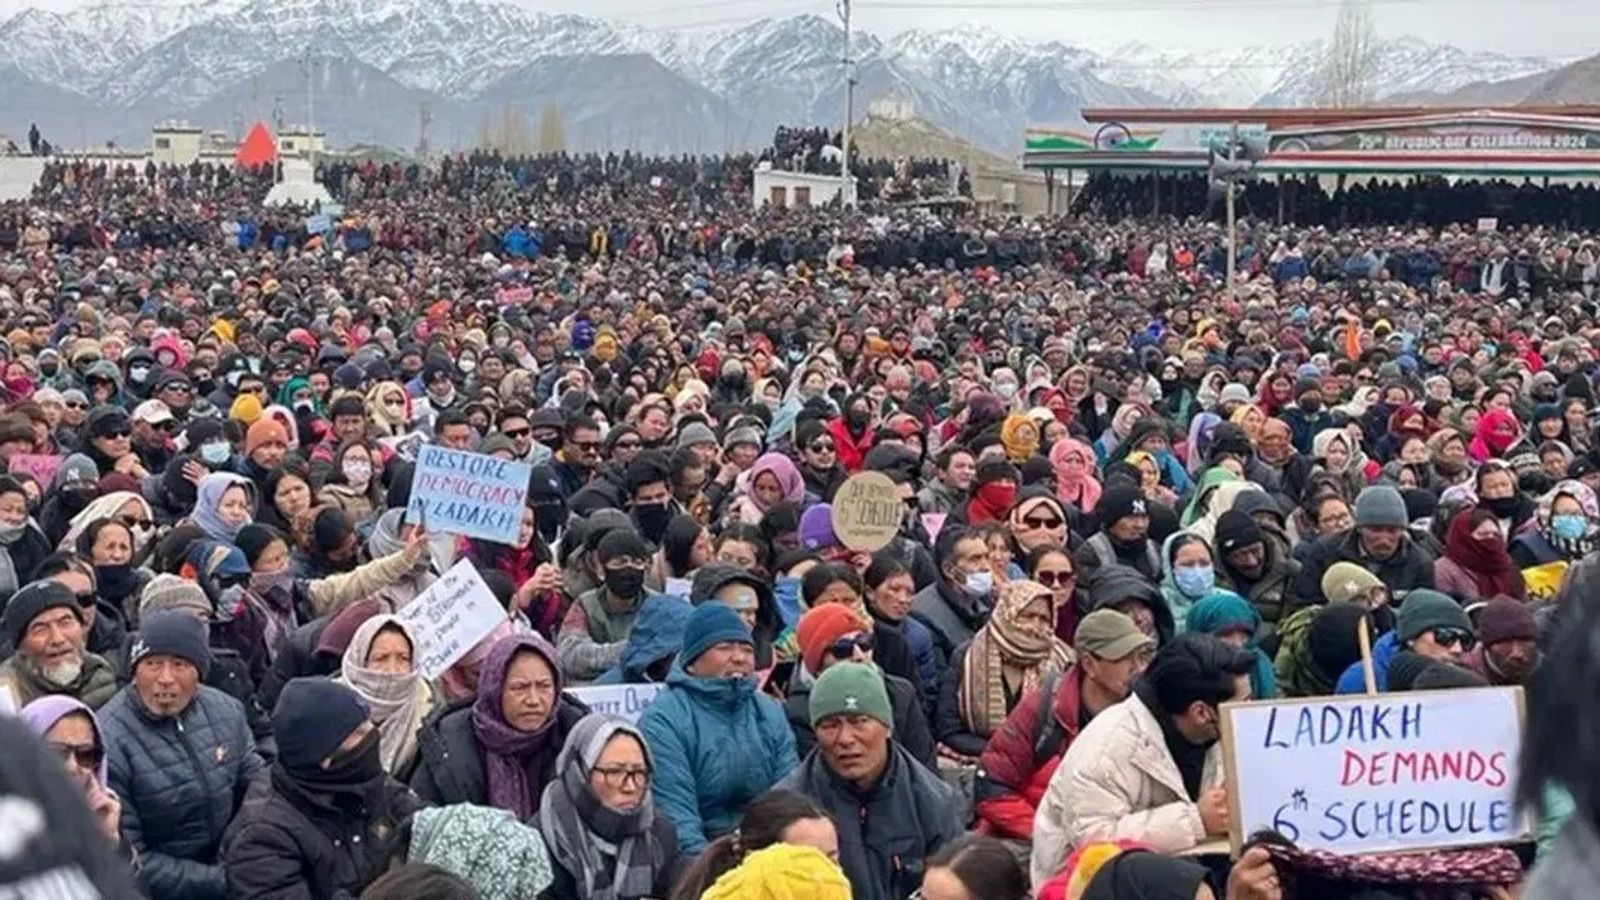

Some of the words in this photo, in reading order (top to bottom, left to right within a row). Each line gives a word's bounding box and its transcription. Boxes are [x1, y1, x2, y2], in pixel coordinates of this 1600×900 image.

[1385, 134, 1442, 149] REPUBLIC
[1445, 135, 1469, 149] DAY
[424, 448, 508, 480] RESTORE
[418, 472, 525, 505] DEMOCRACY
[433, 501, 514, 532] LADAKH
[1264, 703, 1422, 749] LADAKH
[1340, 750, 1507, 787] DEMANDS
[1318, 800, 1511, 842] SCHEDULE
